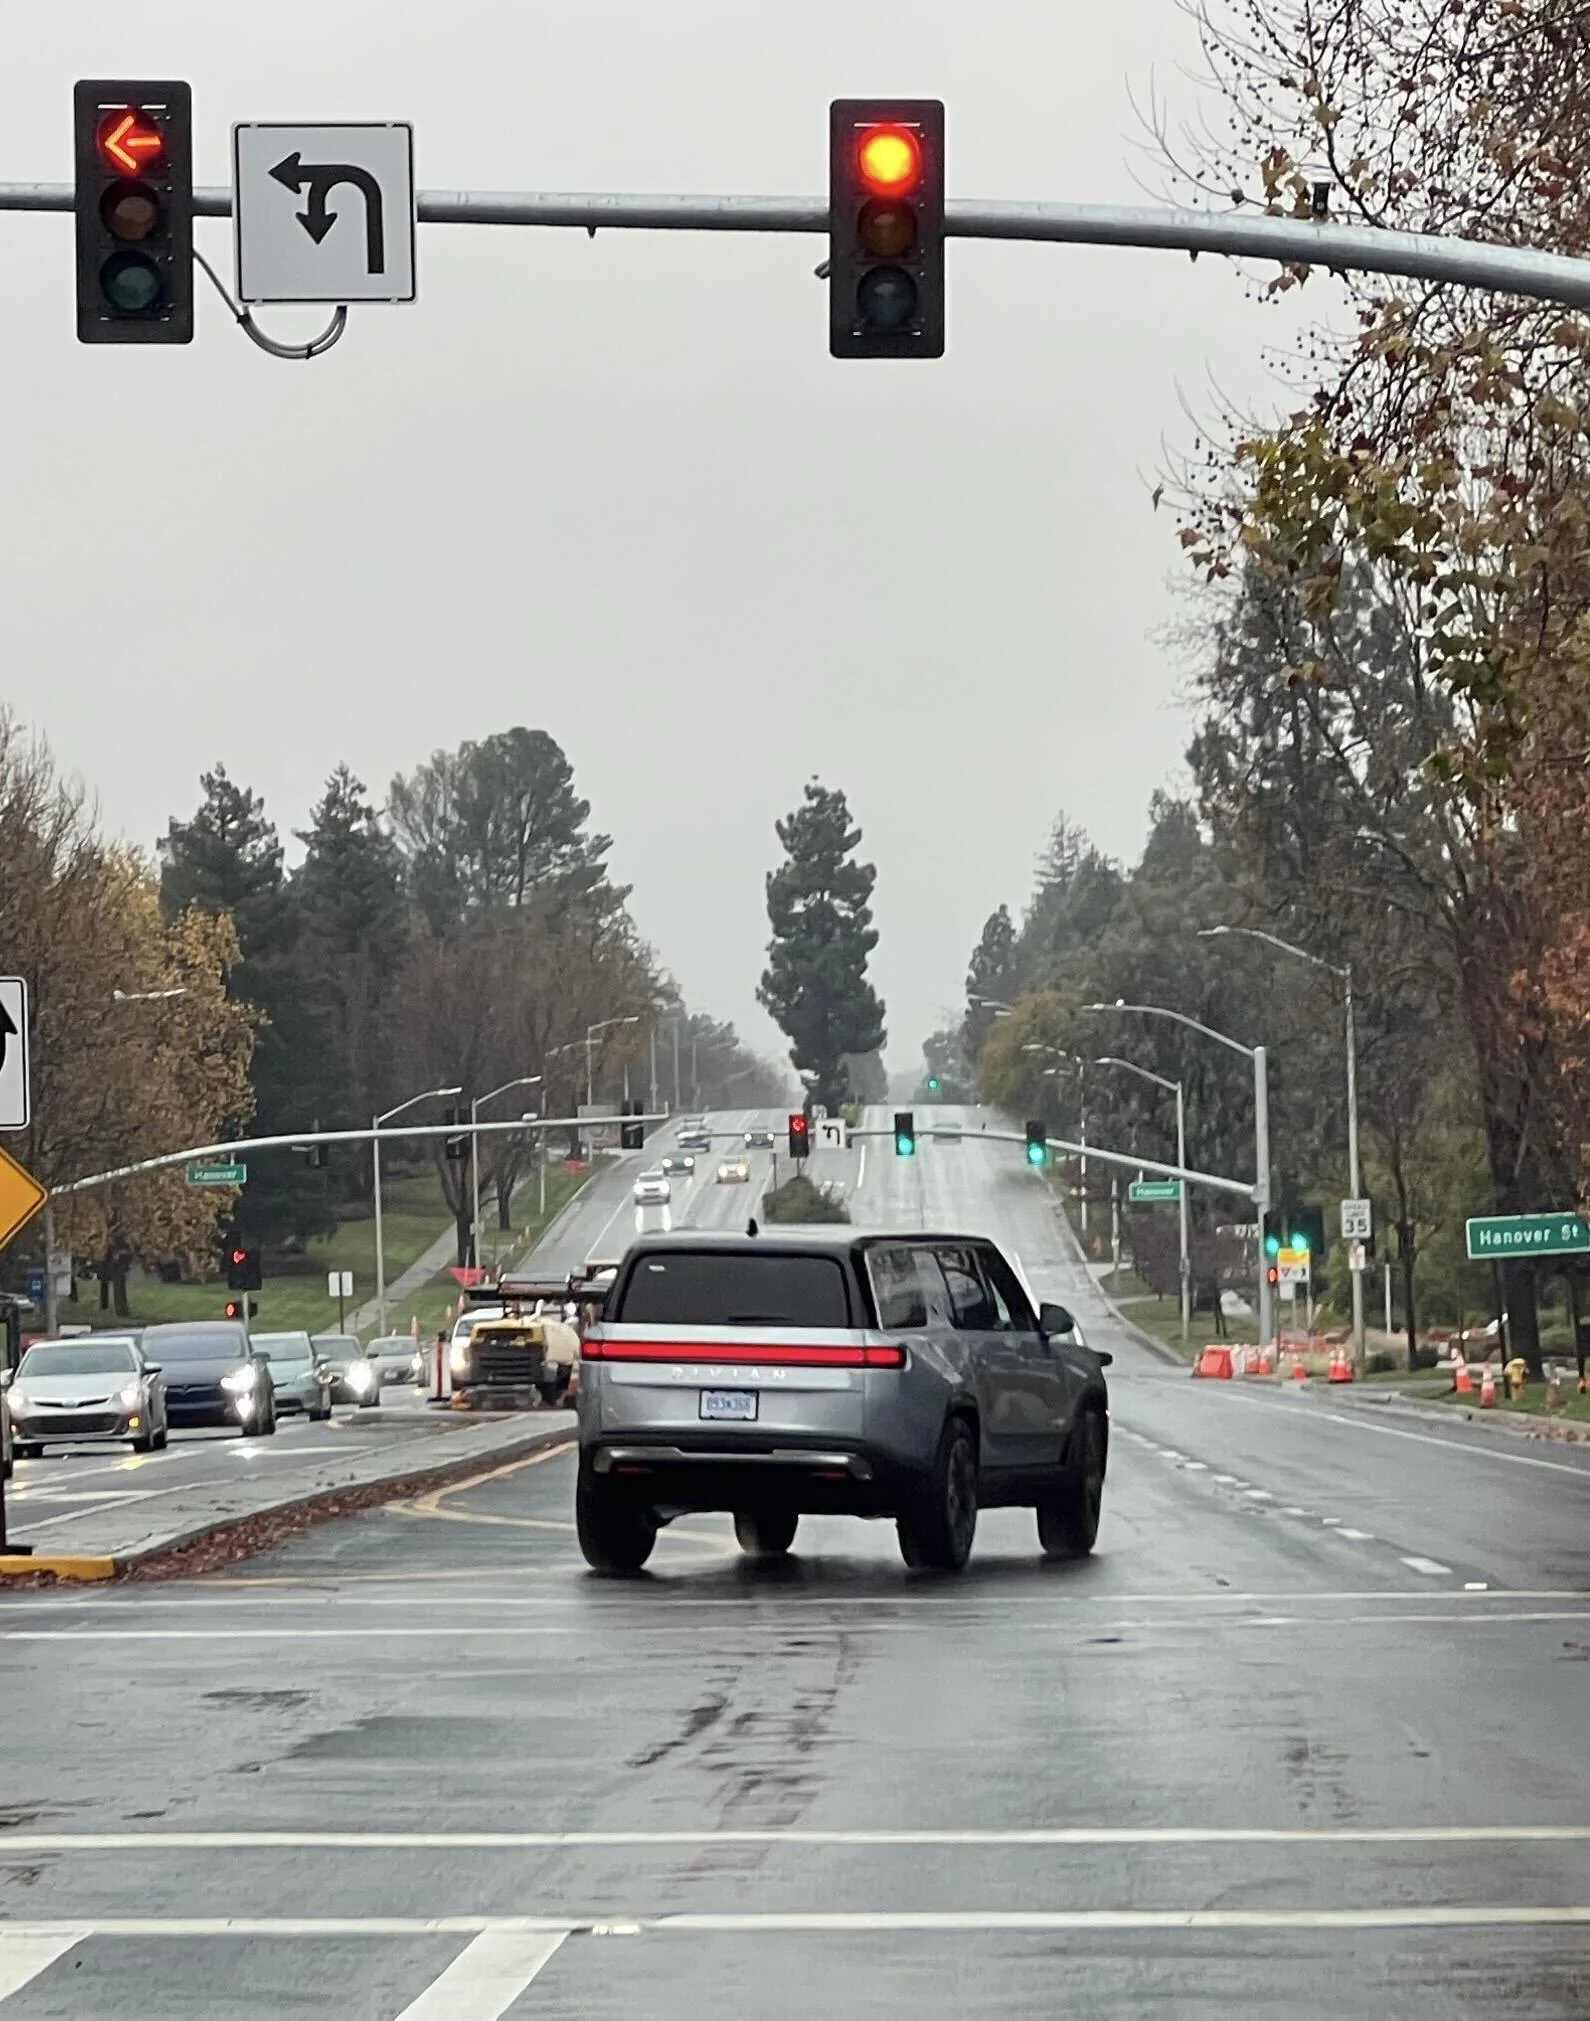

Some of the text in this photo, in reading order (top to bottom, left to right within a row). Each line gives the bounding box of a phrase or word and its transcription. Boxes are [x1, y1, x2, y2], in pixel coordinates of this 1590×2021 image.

[1344, 1218, 1368, 1233] 35
[1480, 1223, 1579, 1246] Hanover St
